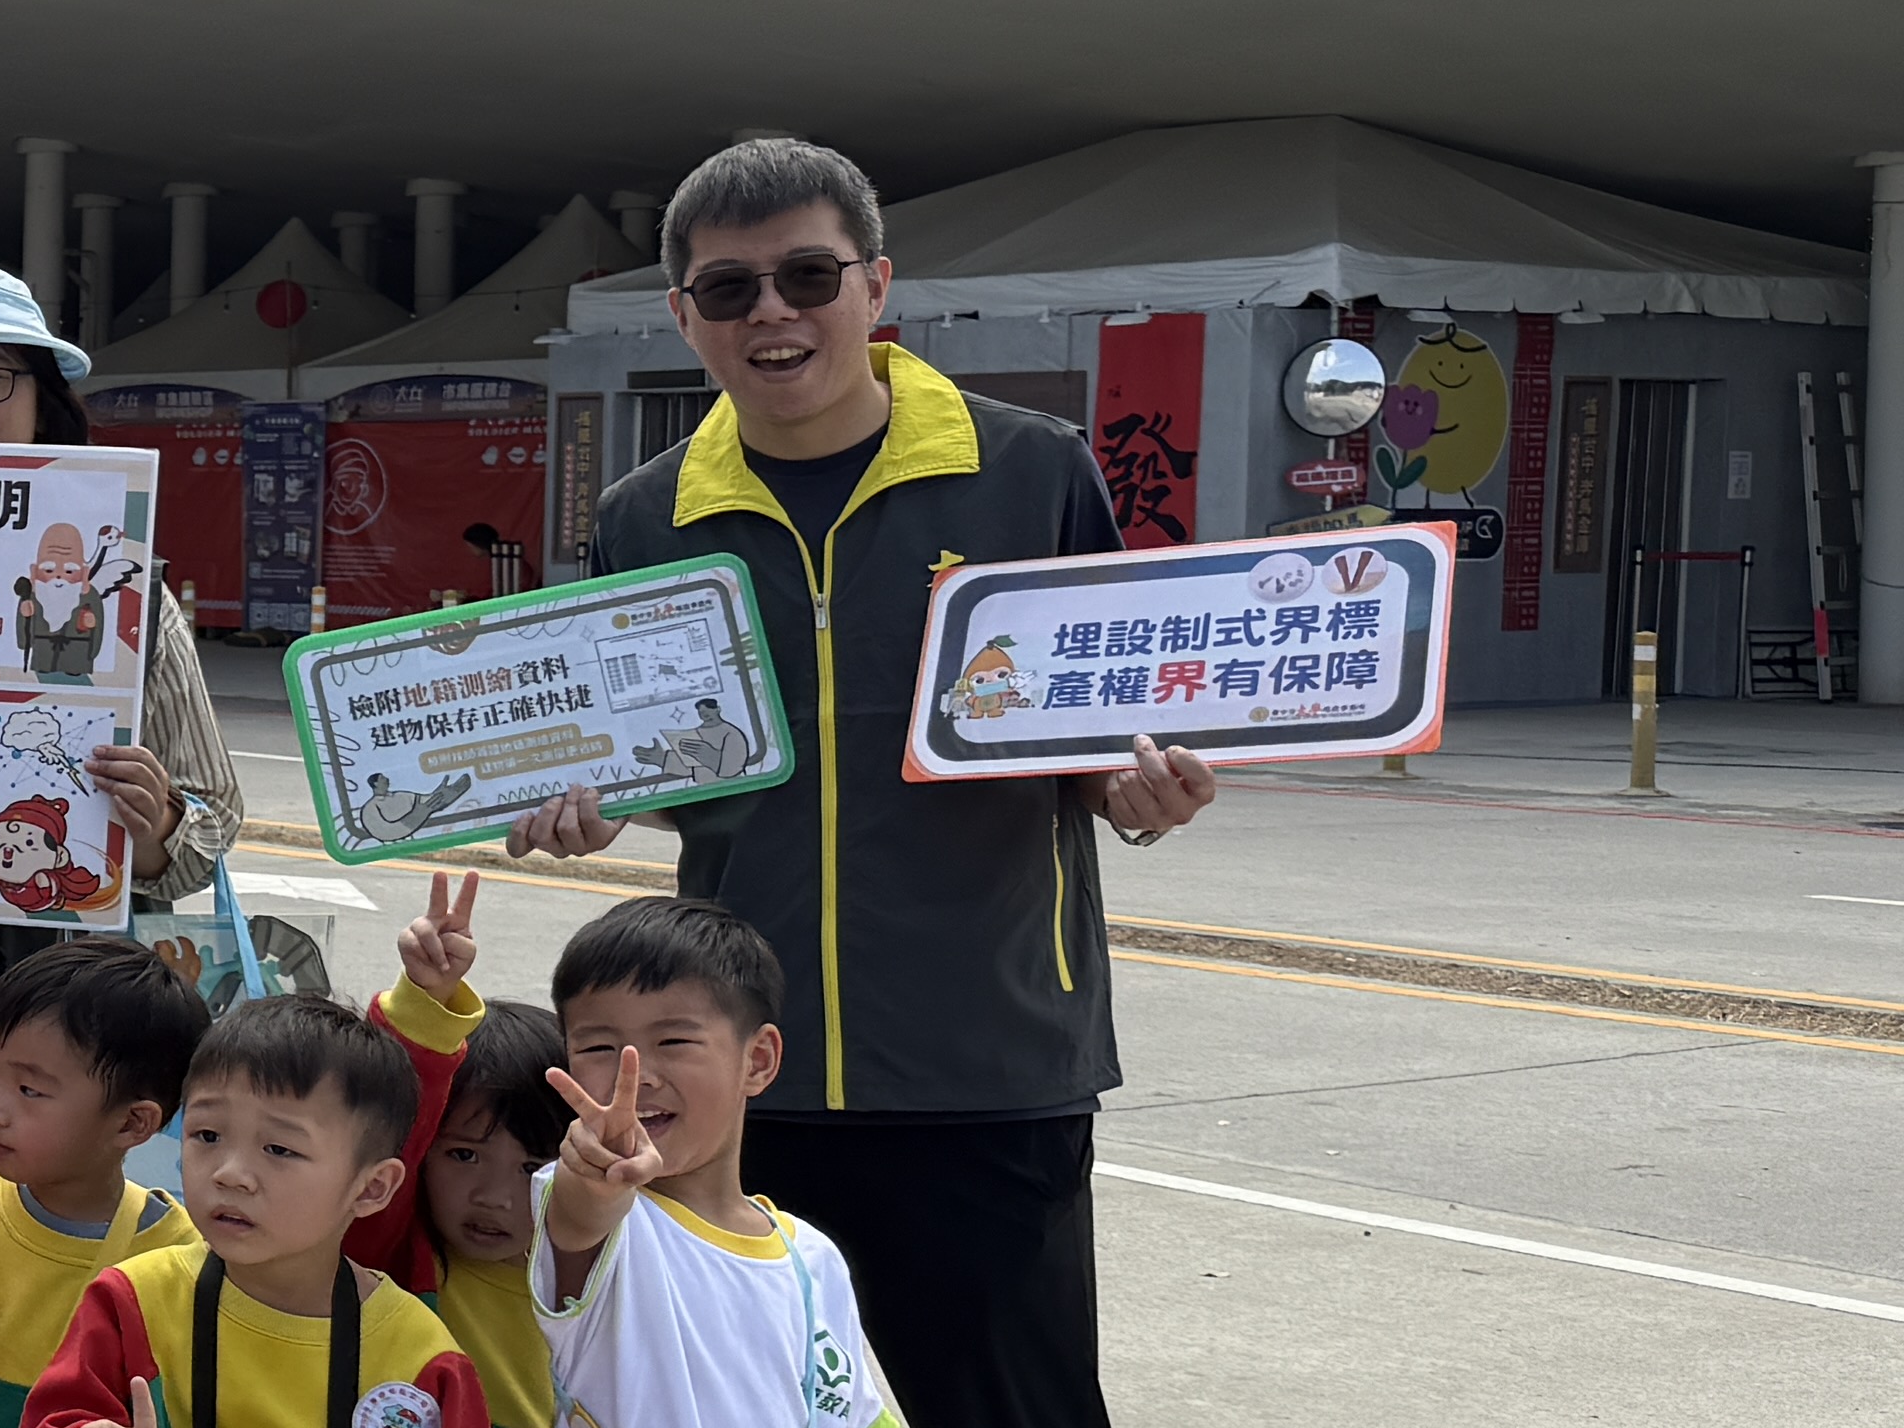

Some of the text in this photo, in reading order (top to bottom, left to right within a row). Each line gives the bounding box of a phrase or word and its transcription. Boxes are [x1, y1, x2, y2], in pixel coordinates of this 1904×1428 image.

[1099, 410, 1198, 542] 發
[1050, 598, 1382, 661] 埋設制式界標
[347, 653, 570, 721] 檢附地籍測繪資料
[1042, 649, 1380, 710] 產權界有保障
[370, 684, 595, 750] 建物保存正確快捷
